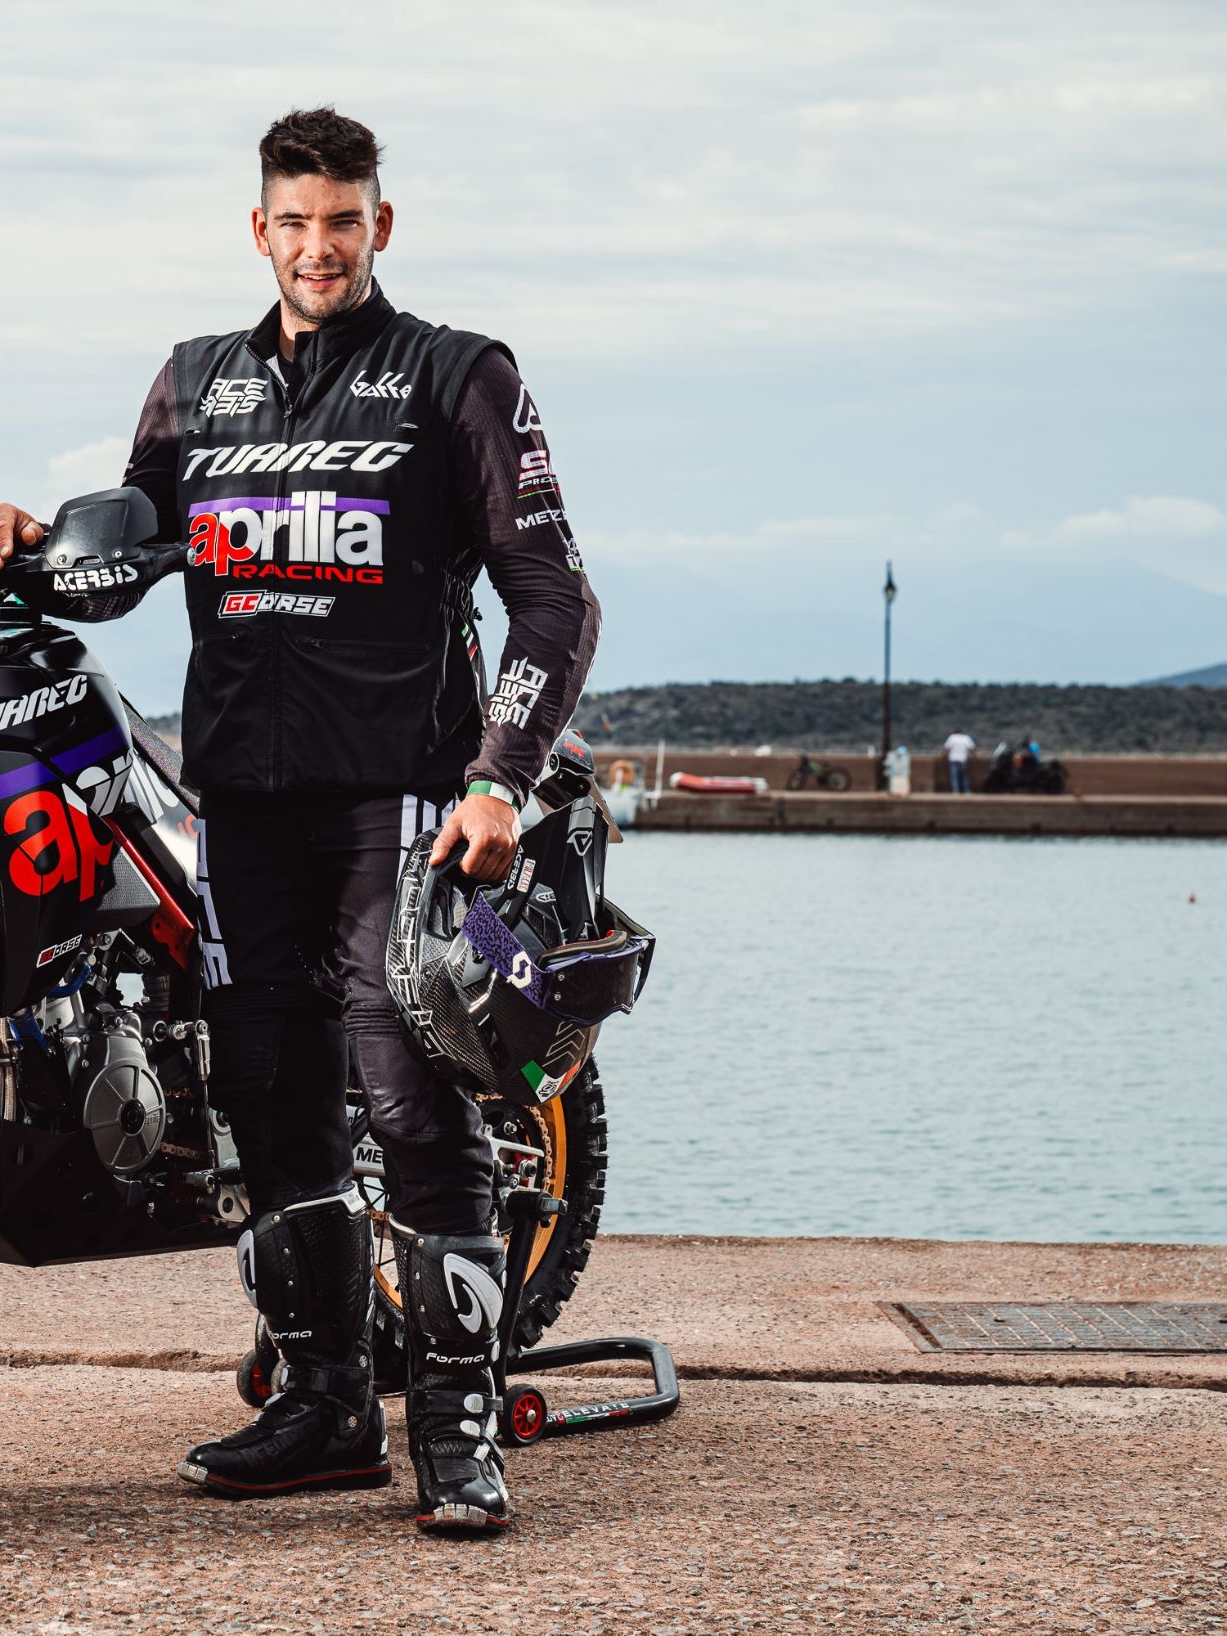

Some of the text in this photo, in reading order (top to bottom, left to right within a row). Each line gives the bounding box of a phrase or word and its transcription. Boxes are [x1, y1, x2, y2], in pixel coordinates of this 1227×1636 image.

[182, 440, 415, 482] TUAREG
[189, 491, 383, 576] aprilia
[232, 564, 383, 584] RACING
[564, 1402, 630, 1417] ELEVATE
